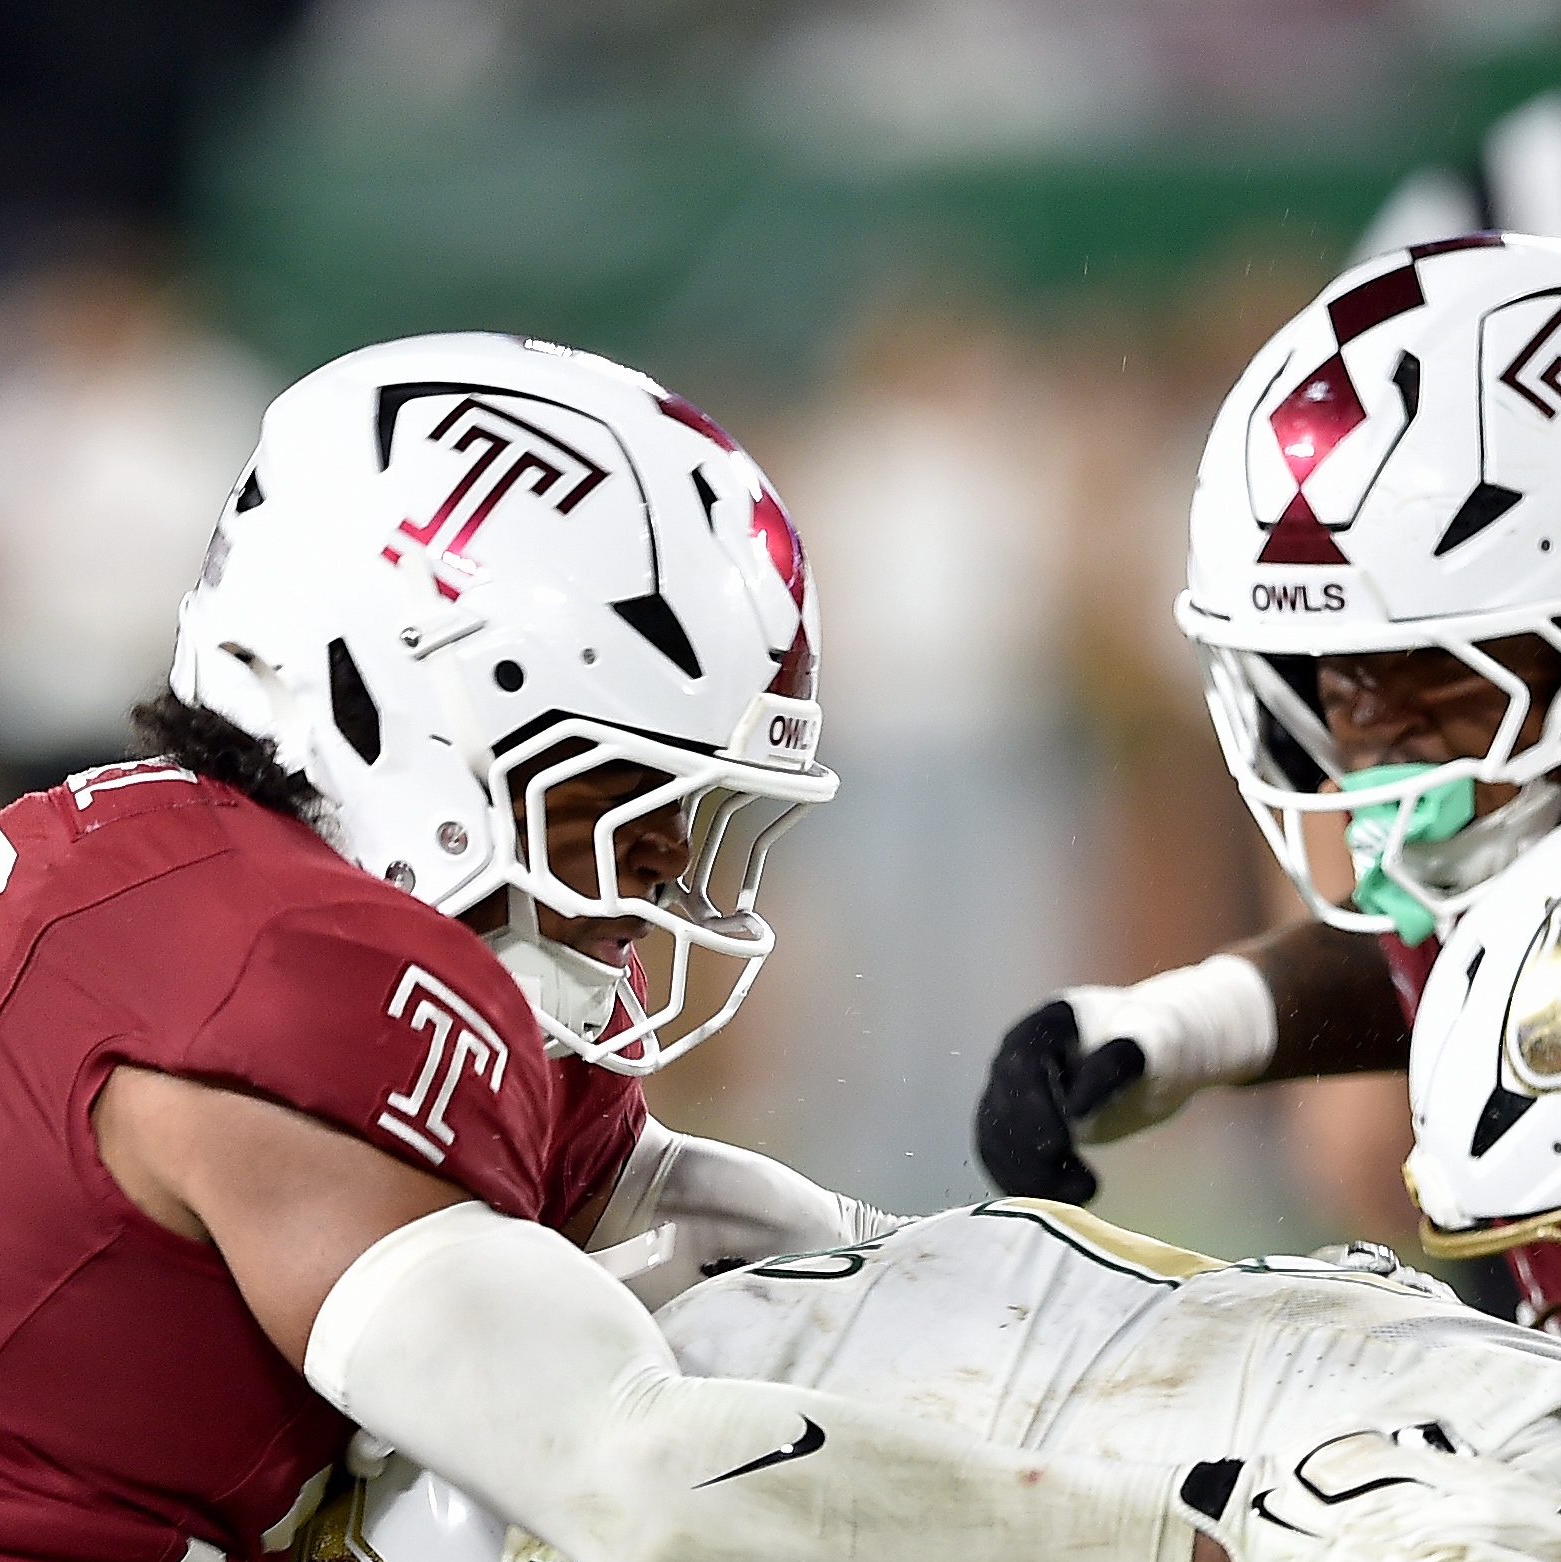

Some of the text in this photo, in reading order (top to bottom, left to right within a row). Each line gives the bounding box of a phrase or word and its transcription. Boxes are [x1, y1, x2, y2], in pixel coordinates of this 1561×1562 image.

[381, 395, 610, 602] T
[1251, 582, 1346, 614] OWLS
[379, 964, 509, 1164] T
